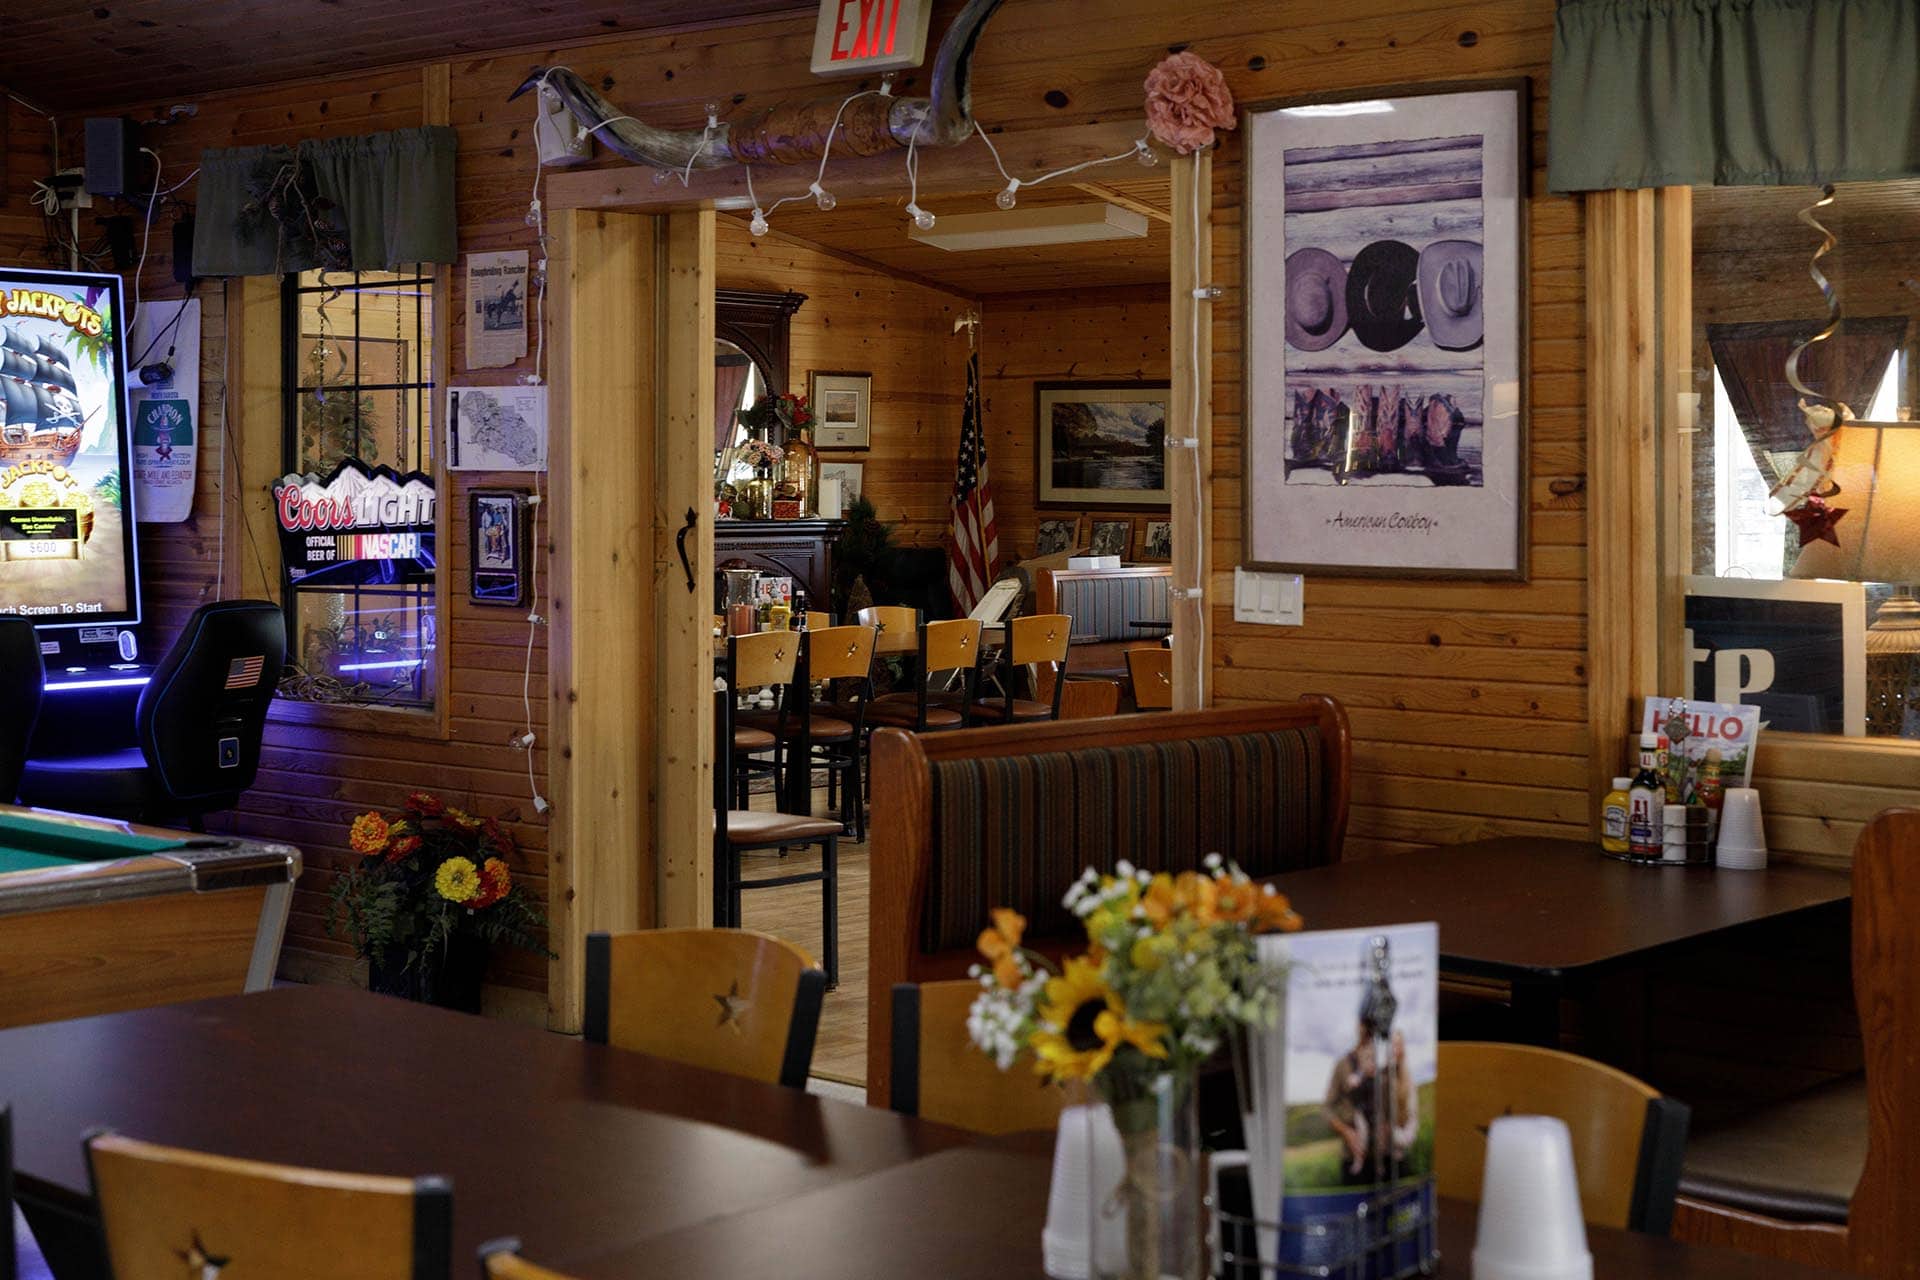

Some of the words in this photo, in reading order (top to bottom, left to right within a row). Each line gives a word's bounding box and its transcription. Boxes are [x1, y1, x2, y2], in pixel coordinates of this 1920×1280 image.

[6, 289, 103, 336] JACKPOTS
[1, 460, 79, 489] JACKPOT
[275, 483, 355, 532] Coors
[354, 494, 436, 528] LIGHT
[1332, 510, 1386, 528] American
[1388, 511, 1433, 535] Cowboy
[30, 542, 56, 552] $600
[306, 536, 336, 547] OFFICIAL
[362, 533, 416, 560] NASCAR
[307, 551, 325, 561] BEER
[326, 550, 336, 560] OF
[759, 583, 789, 595] HEO
[20, 604, 58, 615] Screen
[60, 603, 73, 613] To
[76, 602, 102, 613] Start
